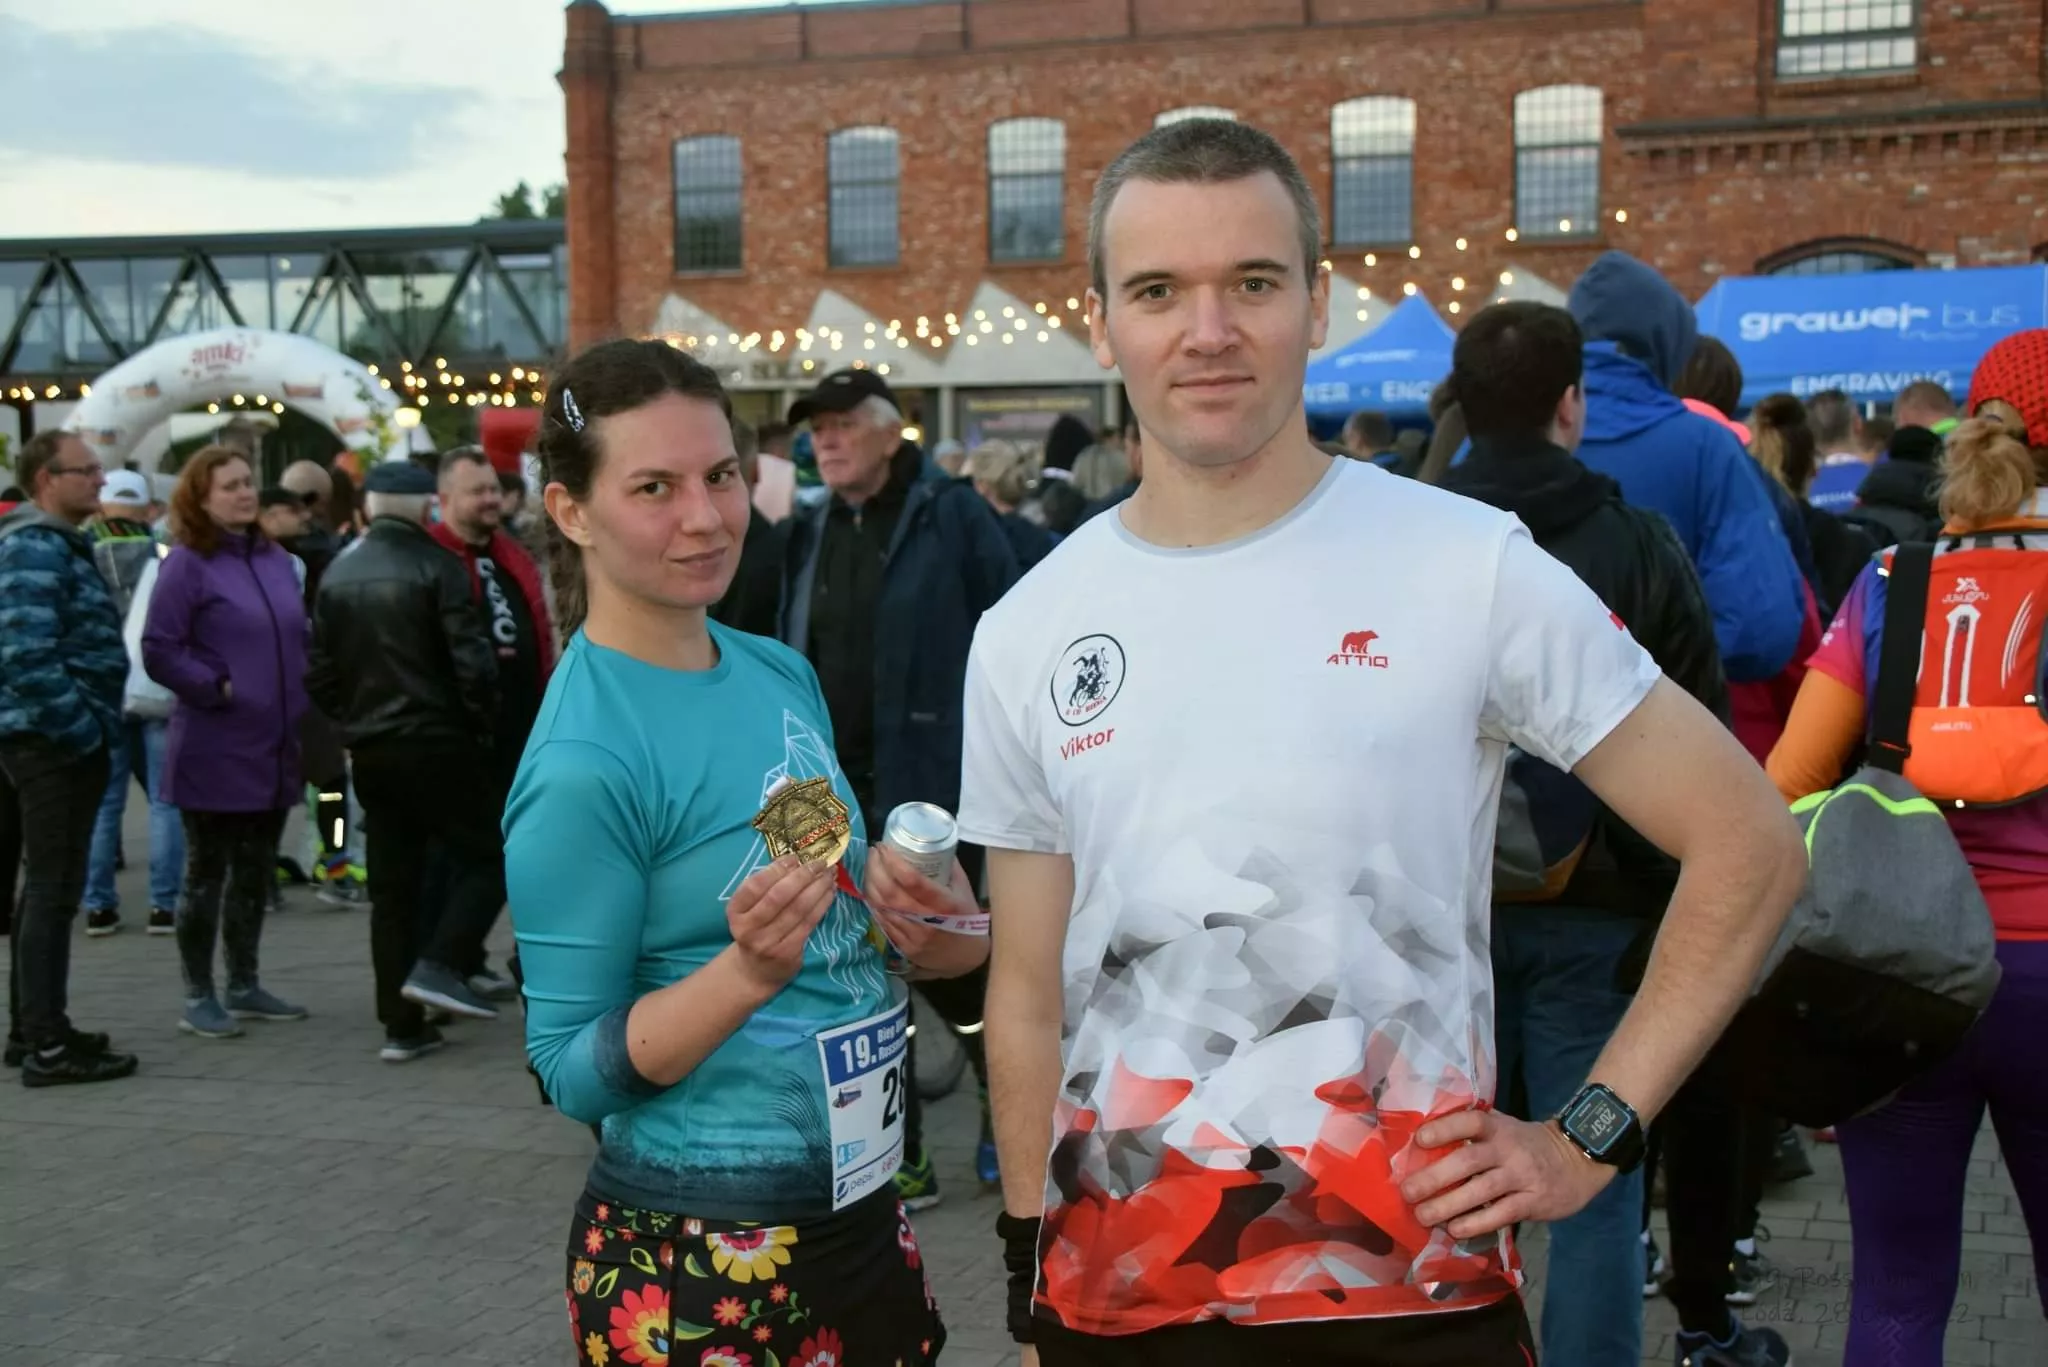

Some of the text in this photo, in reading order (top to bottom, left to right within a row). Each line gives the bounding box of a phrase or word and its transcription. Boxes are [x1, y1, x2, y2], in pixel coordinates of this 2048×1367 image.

[1738, 302, 2020, 342] grawer bus
[1326, 653, 1389, 669] ATTIQ
[1059, 728, 1115, 761] Viktor
[840, 1034, 877, 1074] 19.
[850, 1170, 874, 1193] pepsi
